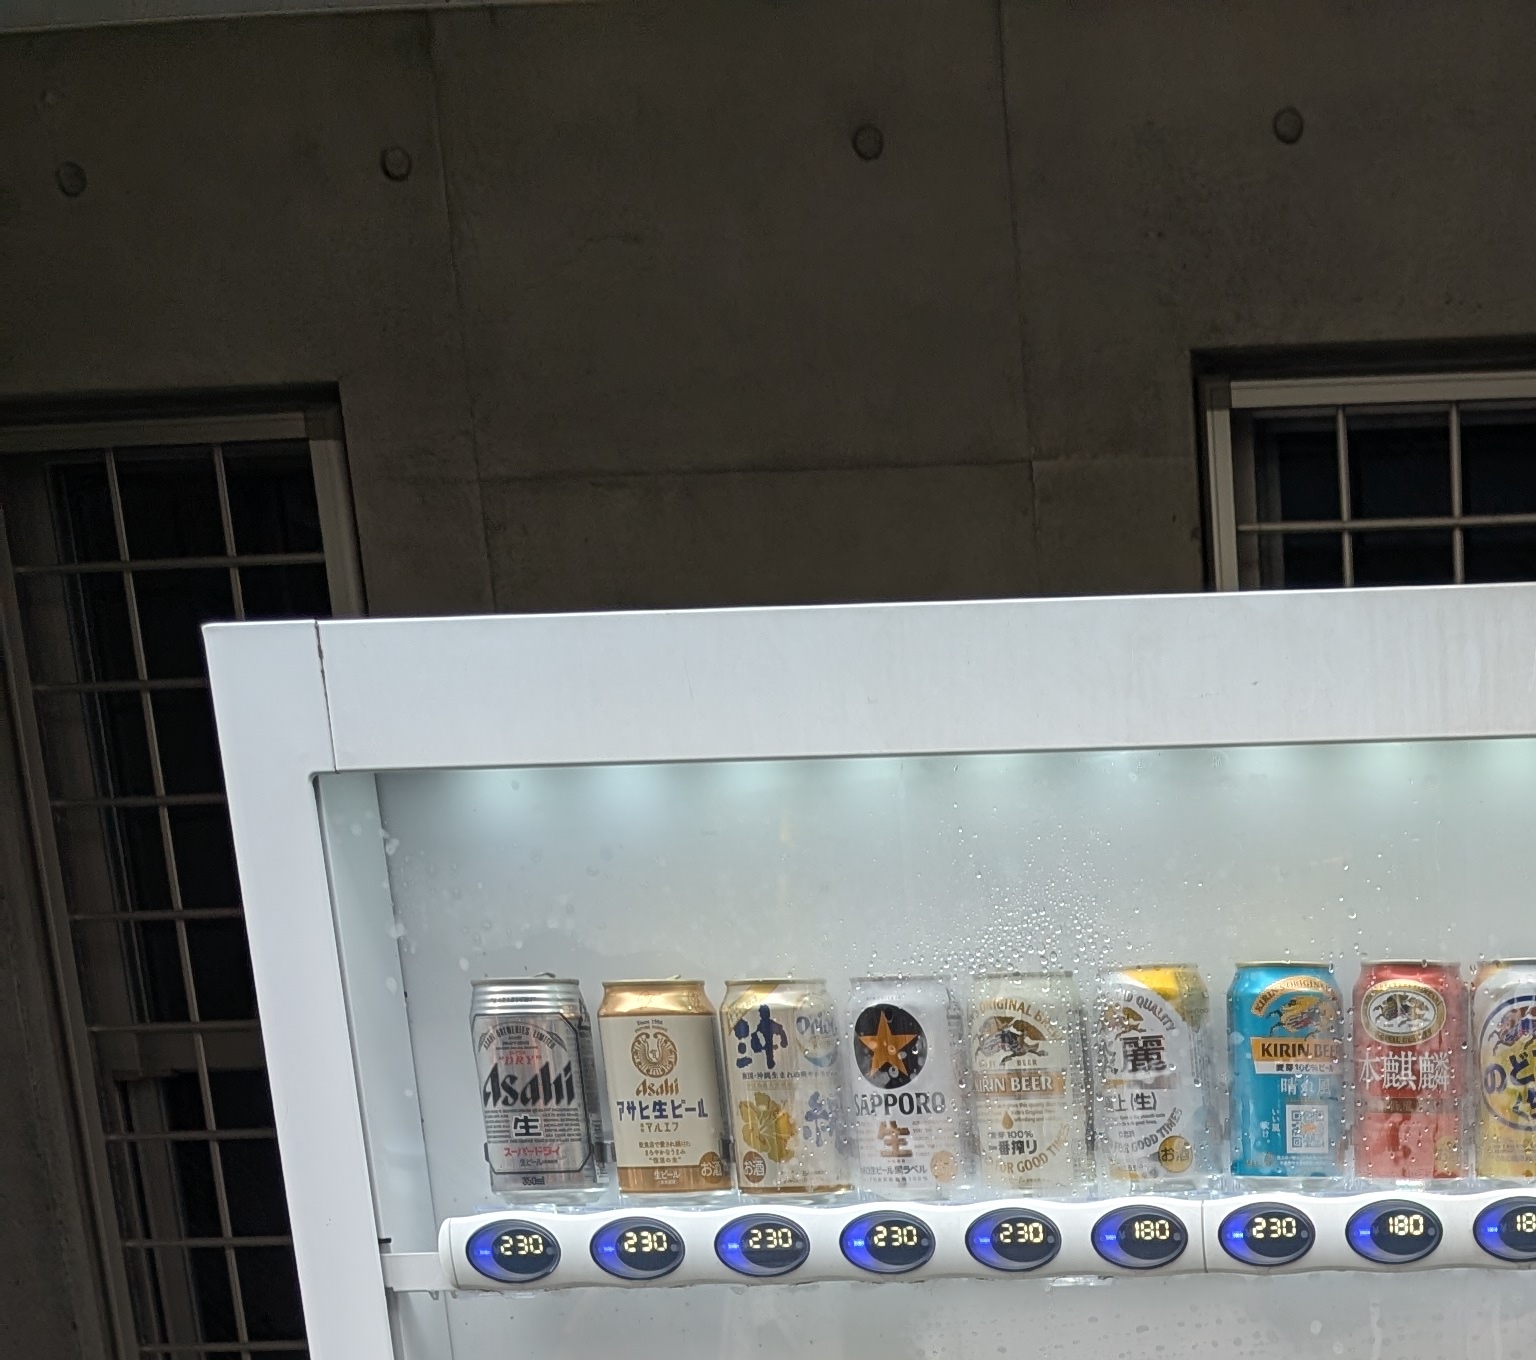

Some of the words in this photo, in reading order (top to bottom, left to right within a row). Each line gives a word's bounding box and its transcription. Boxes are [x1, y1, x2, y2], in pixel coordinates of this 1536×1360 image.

[1261, 1043, 1309, 1058] KIRIN
[1358, 1053, 1451, 1091] 本麒麟
[482, 1060, 577, 1108] Asahi
[635, 1078, 680, 1097] Asahi
[616, 1099, 709, 1122] アサヒ生ビール
[512, 1115, 542, 1138] 生
[874, 1225, 918, 1247] 230
[1000, 1221, 1044, 1243] 230
[1134, 1218, 1170, 1240] 180
[1253, 1217, 1297, 1239] 230
[1388, 1214, 1424, 1236] 180
[500, 1234, 544, 1256] 230
[624, 1231, 668, 1253] 230
